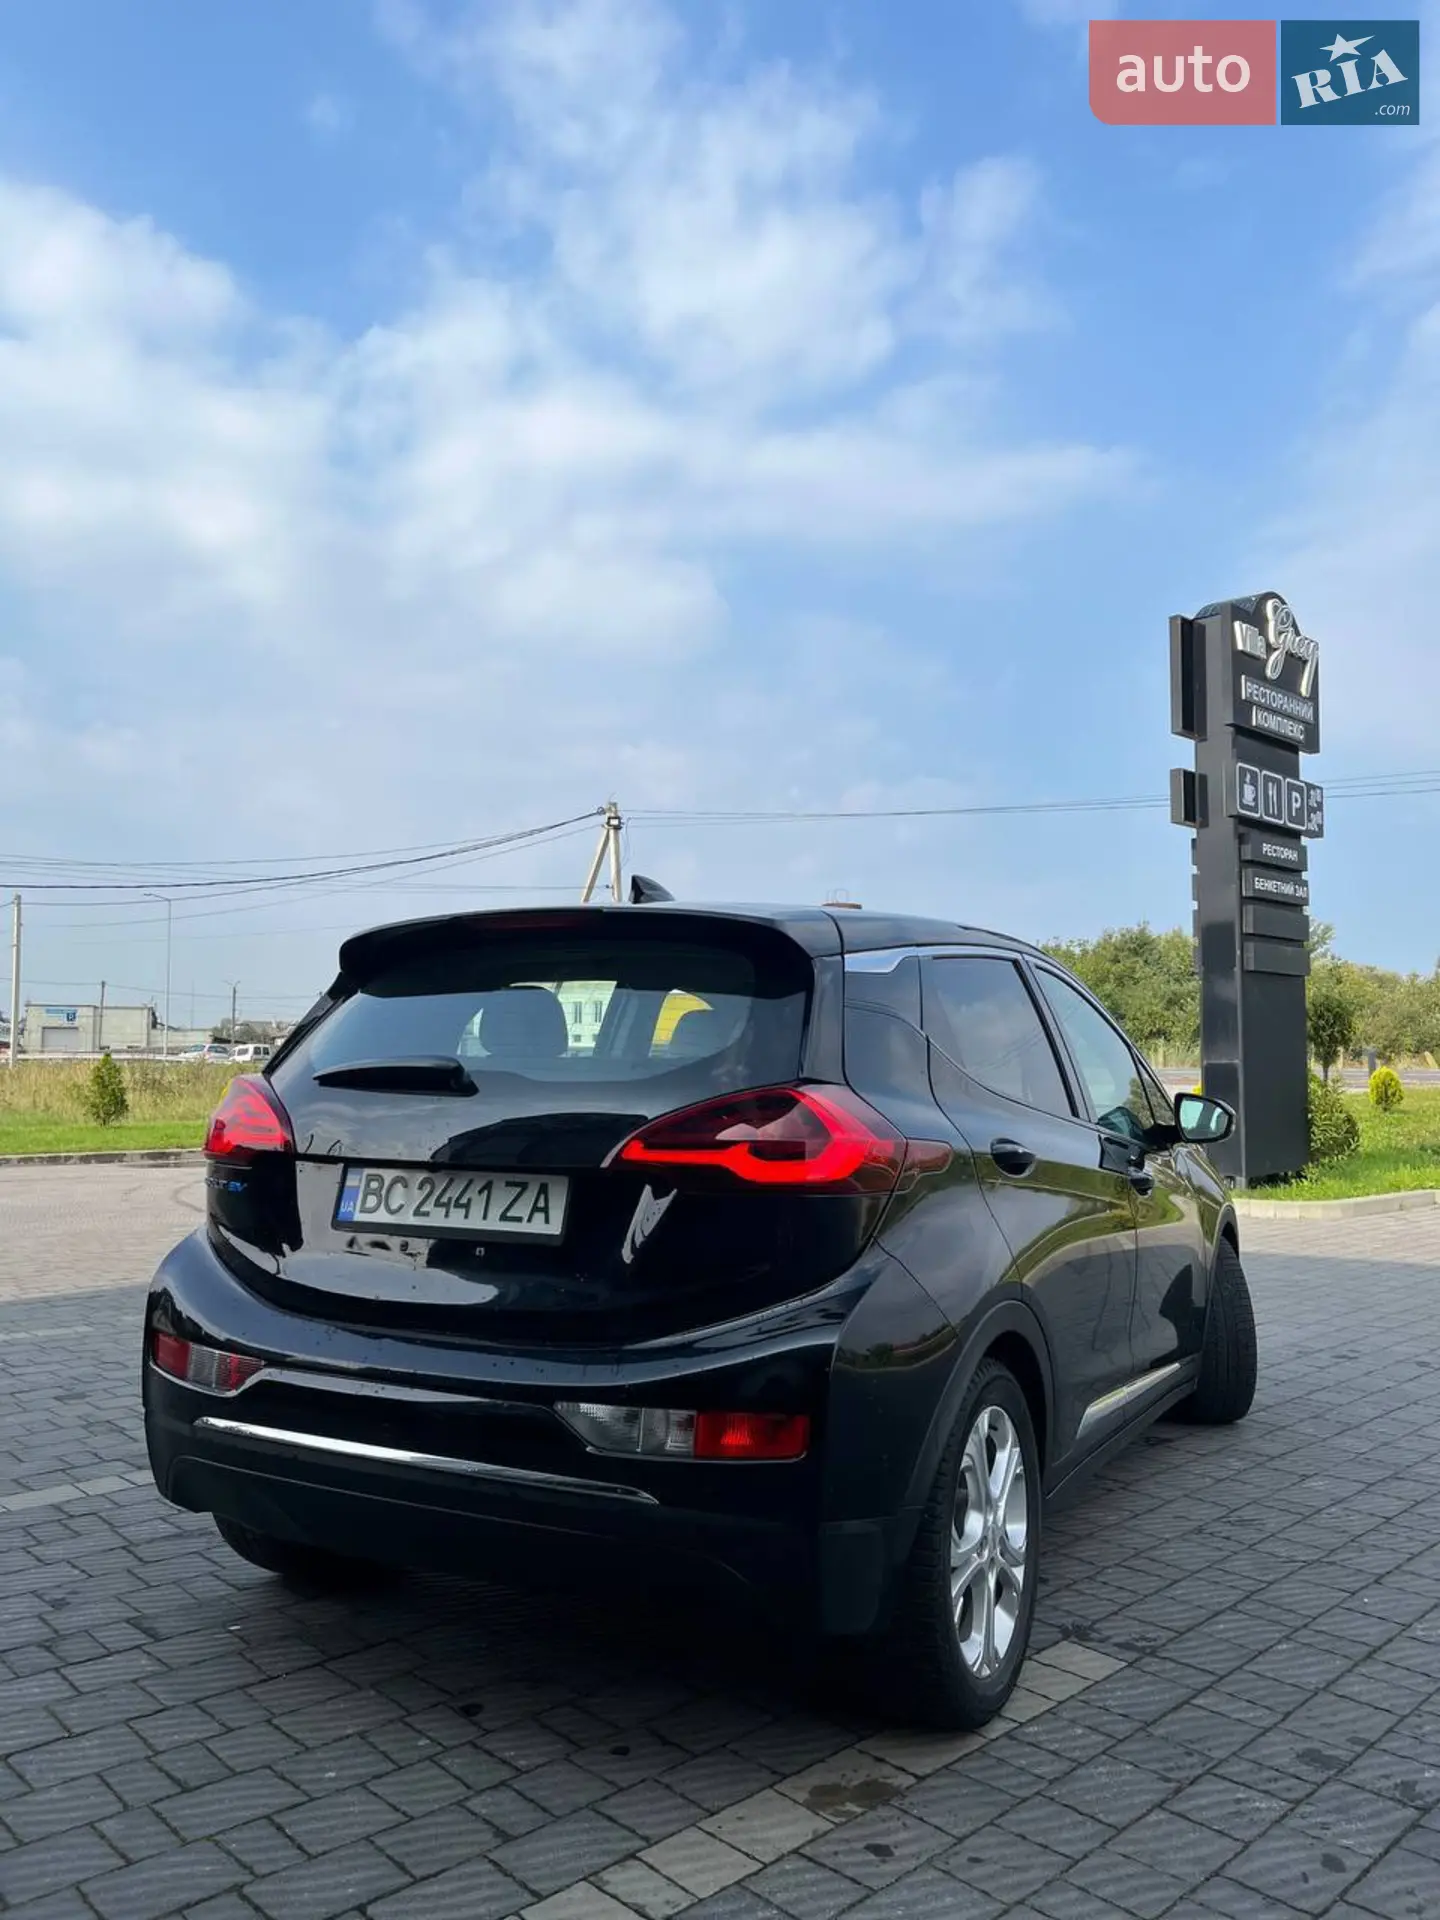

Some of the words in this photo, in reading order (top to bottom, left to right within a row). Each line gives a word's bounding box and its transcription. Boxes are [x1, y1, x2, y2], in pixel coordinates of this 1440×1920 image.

[1257, 708, 1304, 740] КОМПЛЕКС
[1262, 842, 1298, 861] РЕСТОРАН
[341, 1201, 354, 1214] UA
[412, 1176, 494, 1221] 2441
[499, 1180, 550, 1225] ZA
